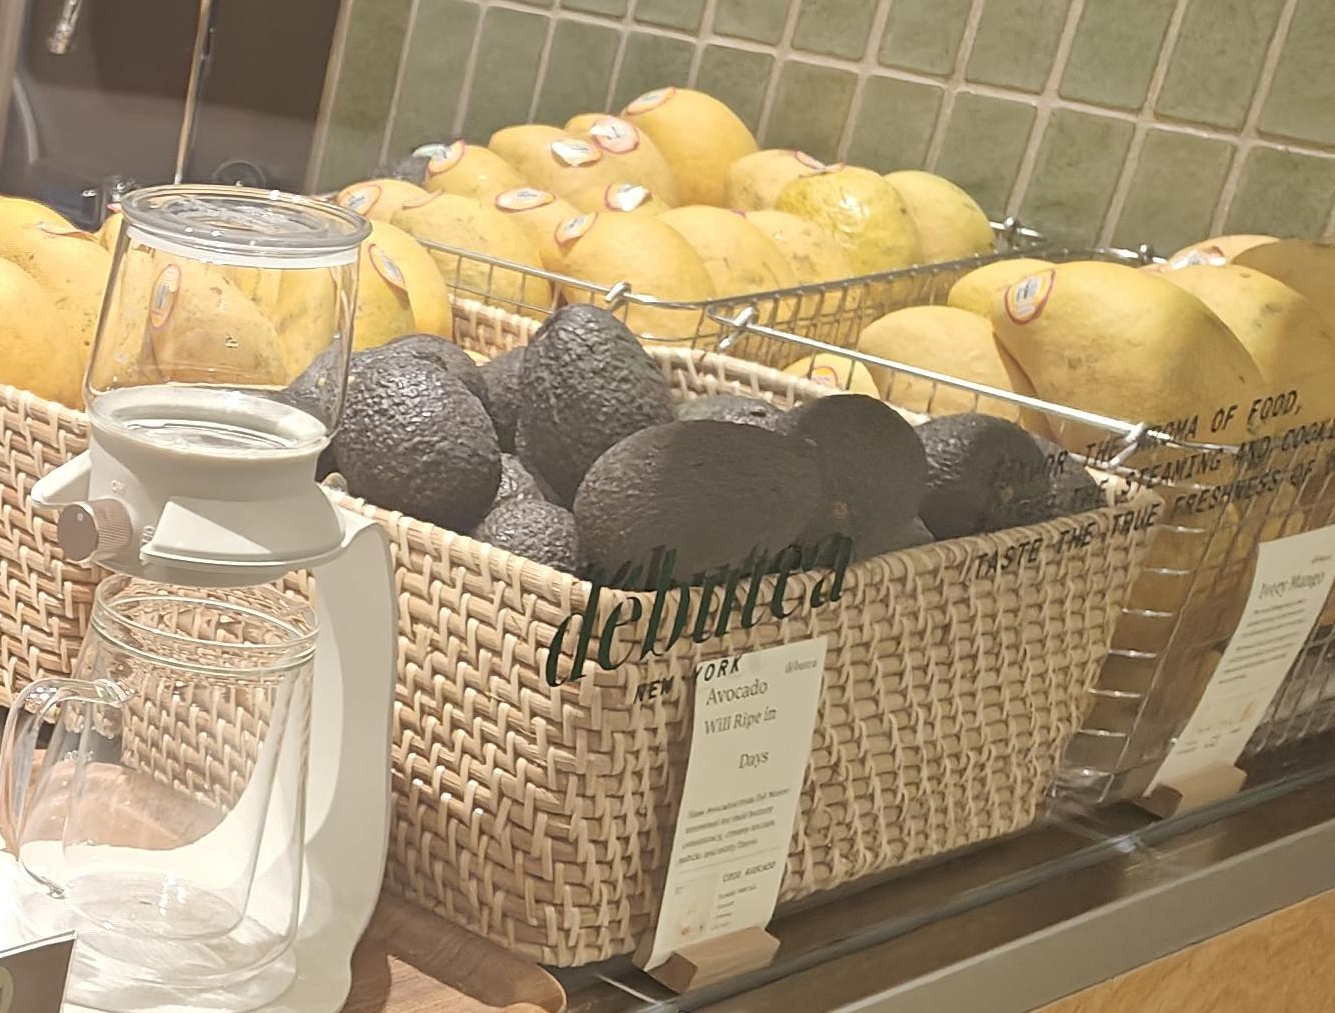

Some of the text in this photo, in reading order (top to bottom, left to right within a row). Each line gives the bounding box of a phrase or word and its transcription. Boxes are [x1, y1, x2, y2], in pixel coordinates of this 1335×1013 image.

[1211, 404, 1238, 433] OF
[1247, 389, 1302, 424] FOOD,
[1121, 448, 1222, 497] STEAMING
[975, 537, 1044, 579] TASTE
[1055, 521, 1097, 554] THE
[1111, 503, 1161, 536] TRUE
[1173, 469, 1282, 516] FRESHNESS
[633, 654, 742, 704] NEW YORK
[706, 679, 769, 706] Avocado
[704, 706, 777, 734] Will Ripe in
[738, 751, 769, 769] Days
